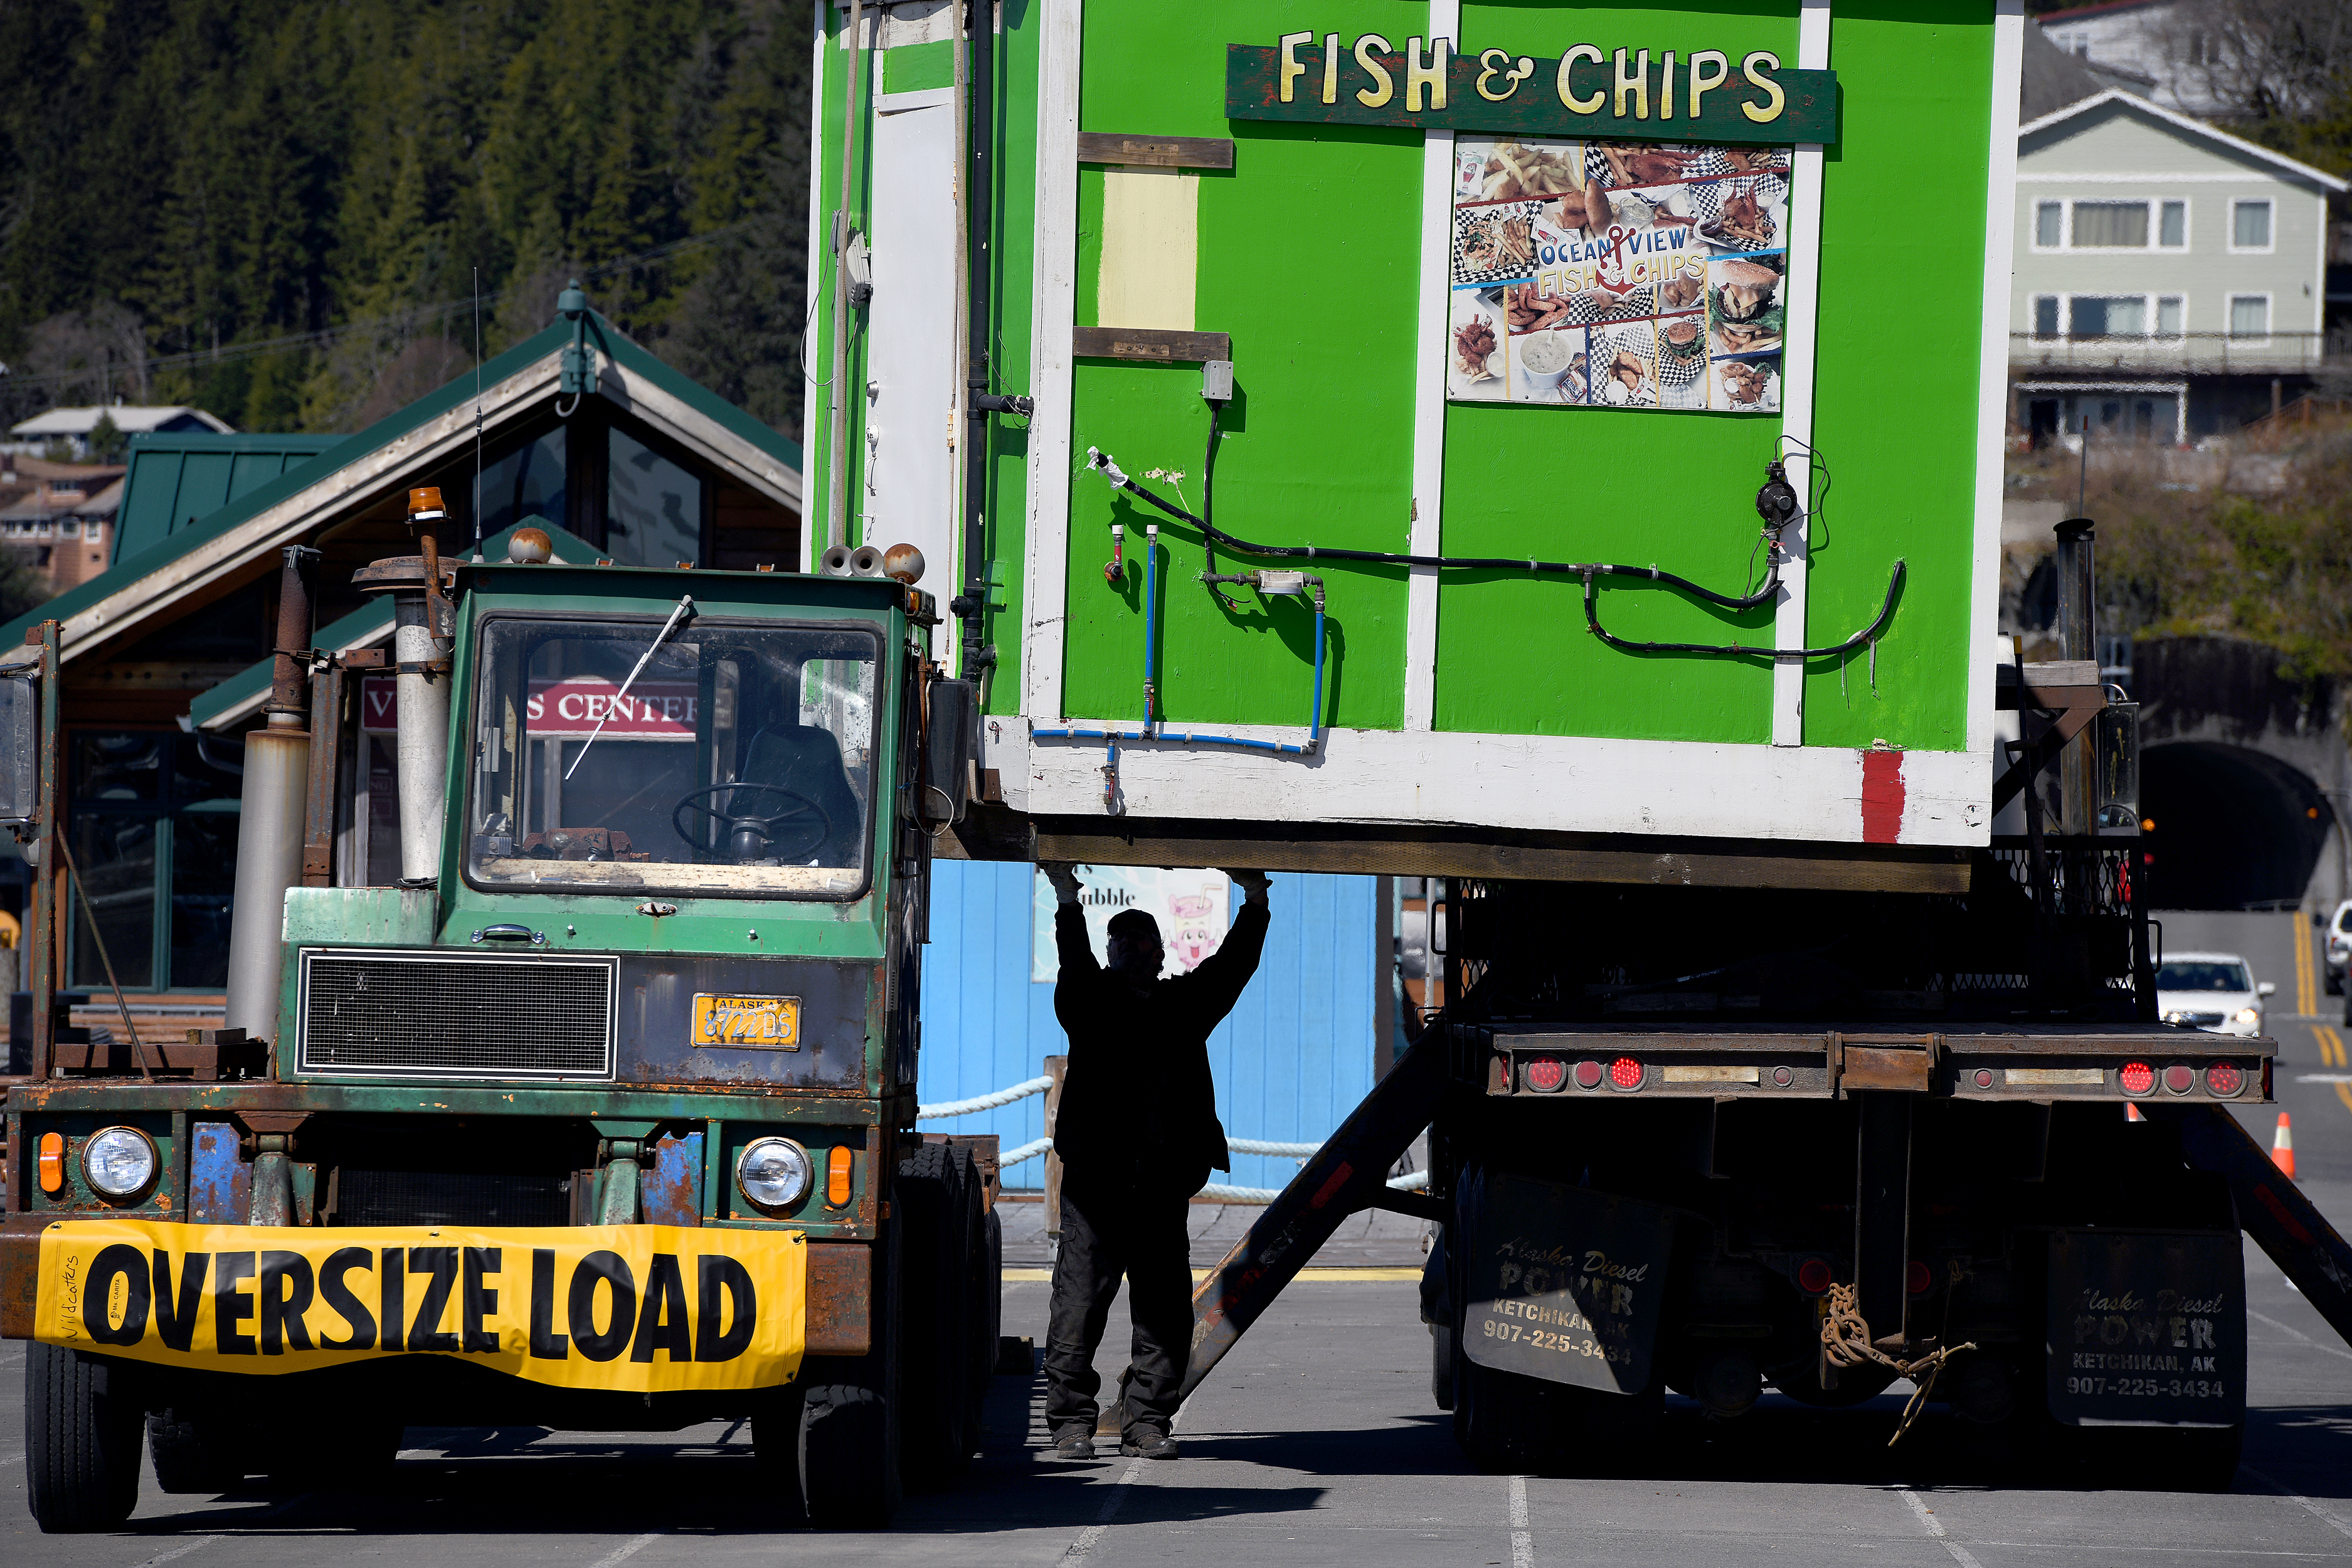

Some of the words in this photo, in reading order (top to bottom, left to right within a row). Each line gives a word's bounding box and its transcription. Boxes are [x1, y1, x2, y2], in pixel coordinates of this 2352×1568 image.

[1279, 30, 1449, 113] FISH
[1475, 48, 1537, 103] &
[1556, 43, 1786, 124] CHIPS
[1541, 238, 1611, 265] OCEAN
[1628, 227, 1687, 255] VIEW
[1539, 264, 1599, 297] FISH
[1609, 265, 1624, 282] &
[1631, 254, 1704, 284] CHIPS
[1565, 378, 1582, 396] KRISY
[1076, 888, 1136, 906] ubble
[719, 1000, 775, 1010] ALASKA
[1583, 1250, 1648, 1282] Diesel
[82, 1244, 501, 1355] OVERSIZE
[529, 1248, 756, 1363] LOAD
[1499, 1259, 1633, 1316] POWER
[2070, 1288, 2147, 1311] laska
[2157, 1290, 2223, 1313] Diesel
[1484, 1320, 1631, 1365] 907-225-3434
[1604, 1320, 1629, 1338] AK
[2074, 1313, 2217, 1349] POWER
[2073, 1353, 2184, 1374] KETCHIKAN,
[2191, 1356, 2216, 1372] AK
[2067, 1376, 2224, 1398] 907-225-3434
